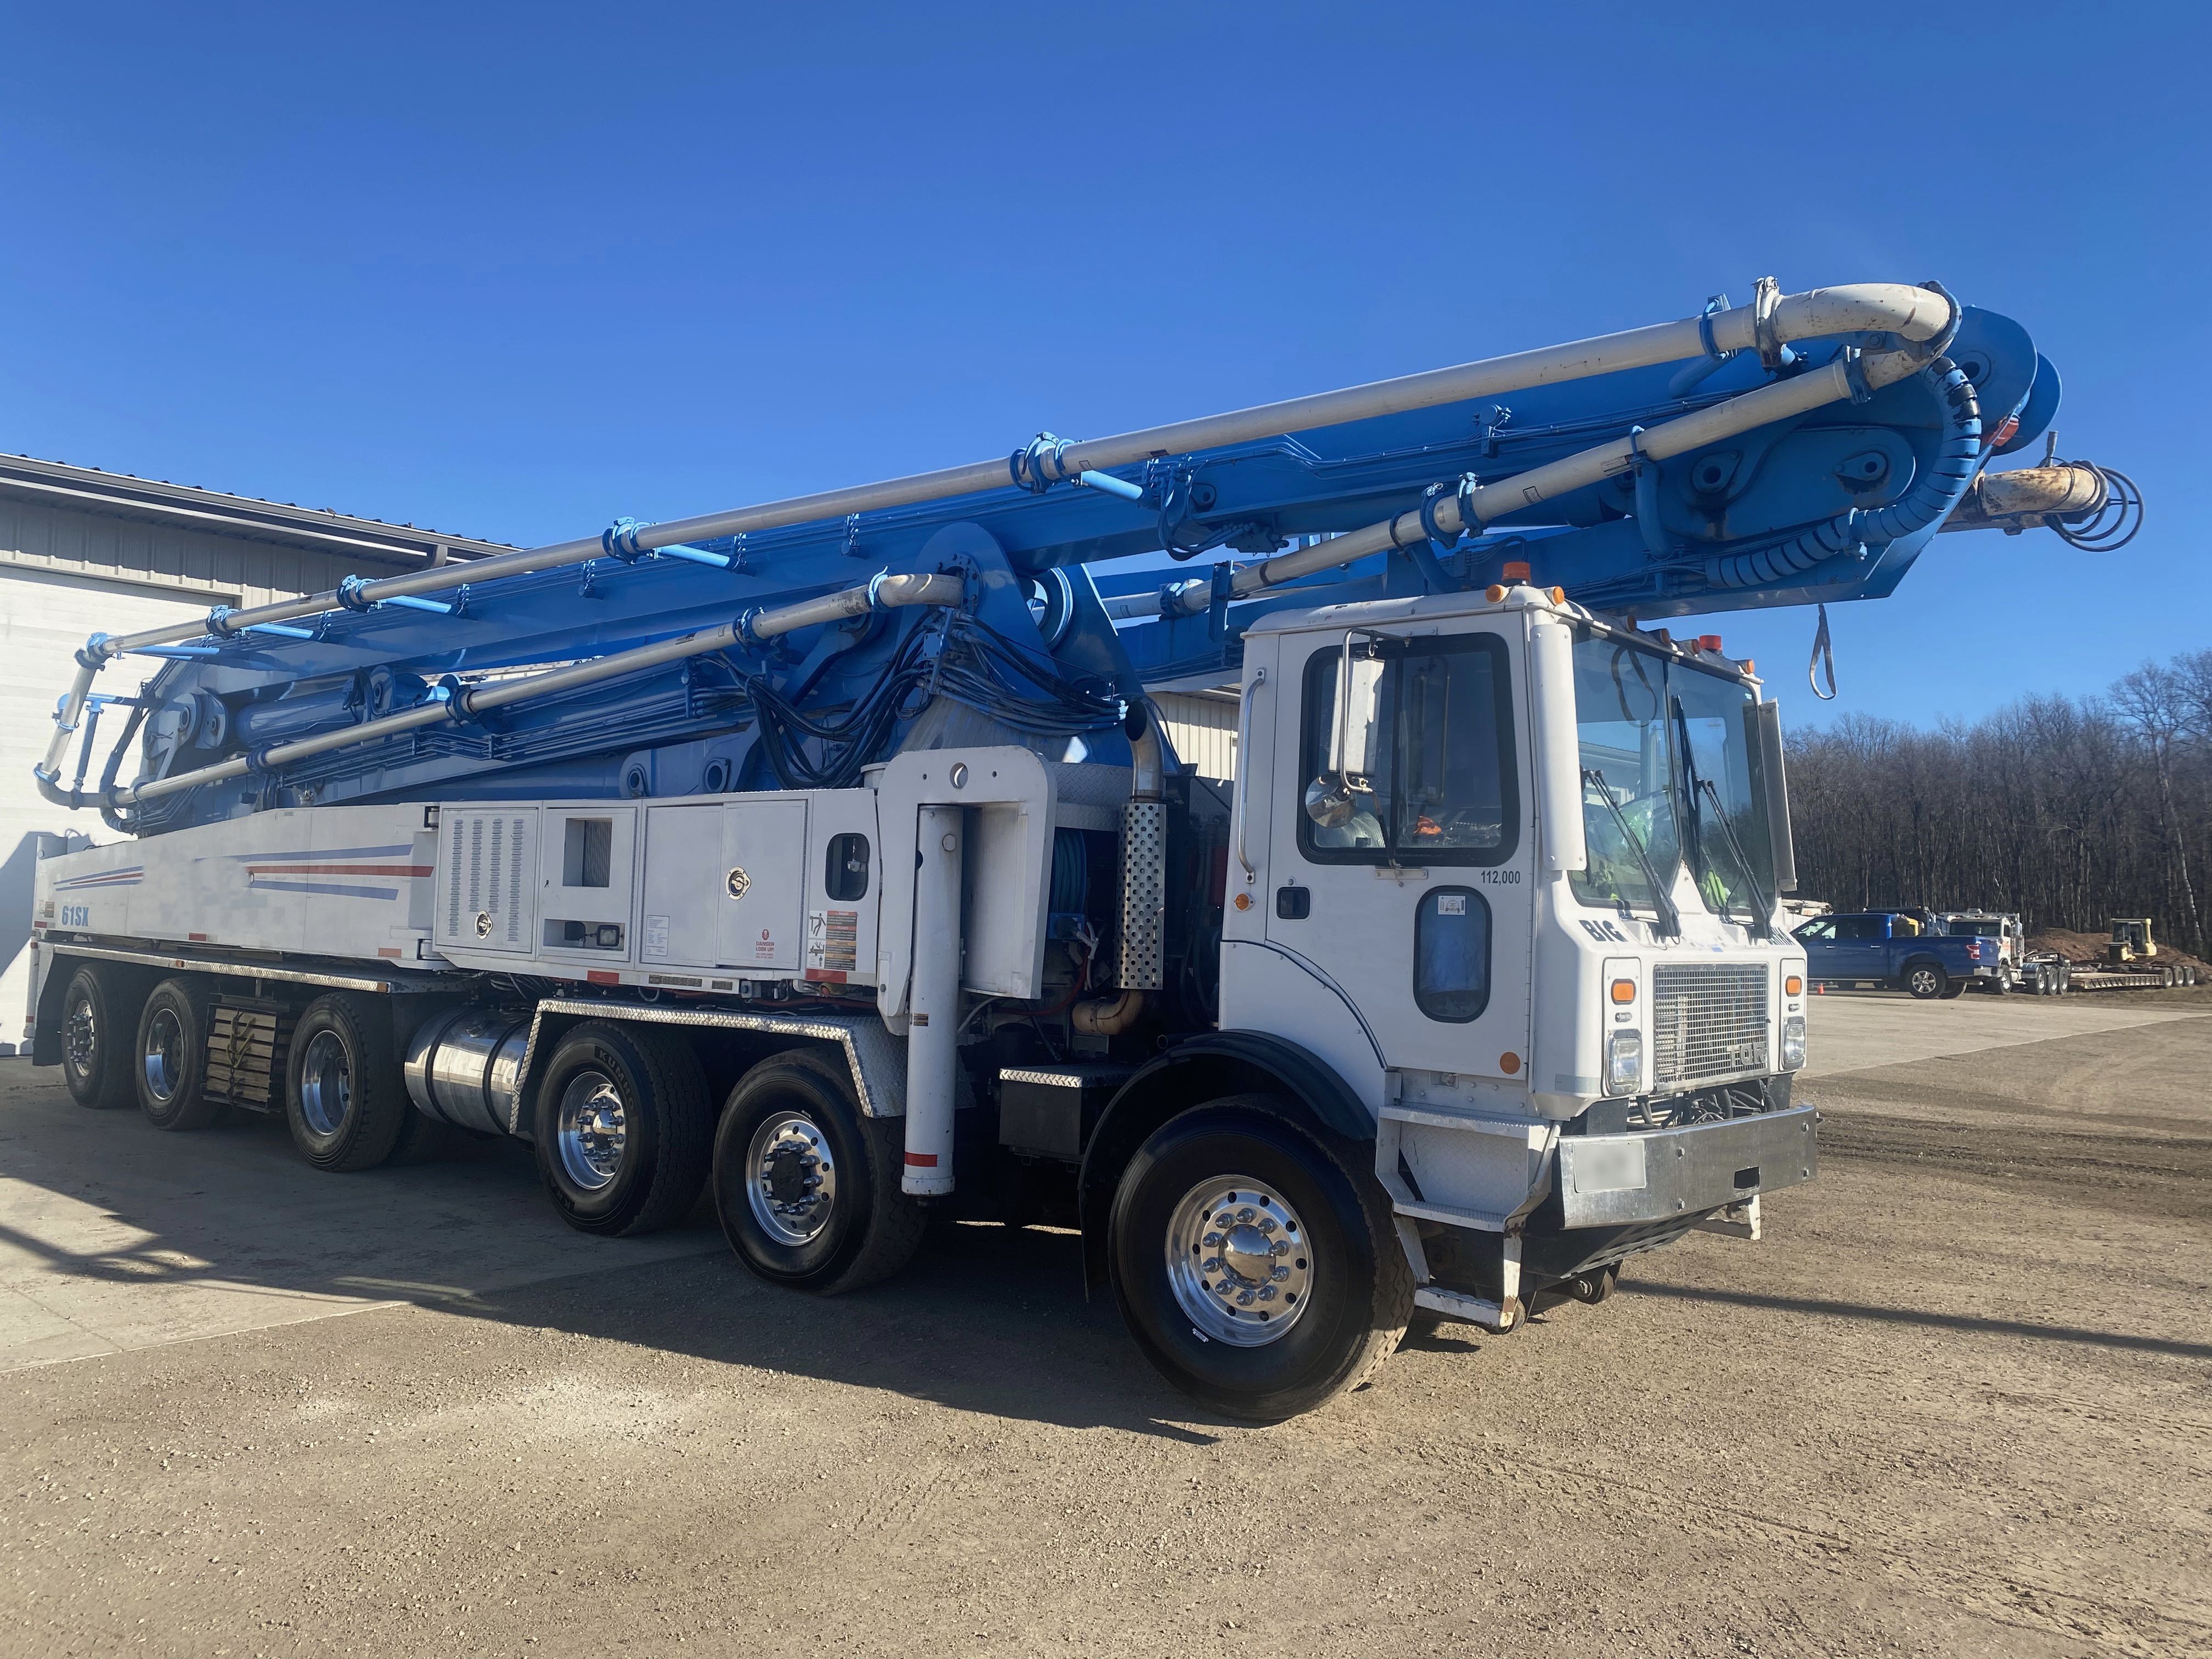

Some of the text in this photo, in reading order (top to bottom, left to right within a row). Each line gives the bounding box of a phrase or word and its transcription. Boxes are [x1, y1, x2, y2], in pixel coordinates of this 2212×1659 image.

[1481, 870, 1521, 886] 112,000
[61, 905, 89, 927] 61SX
[1578, 920, 1628, 942] BIG
[599, 1048, 634, 1110] KUMHO
